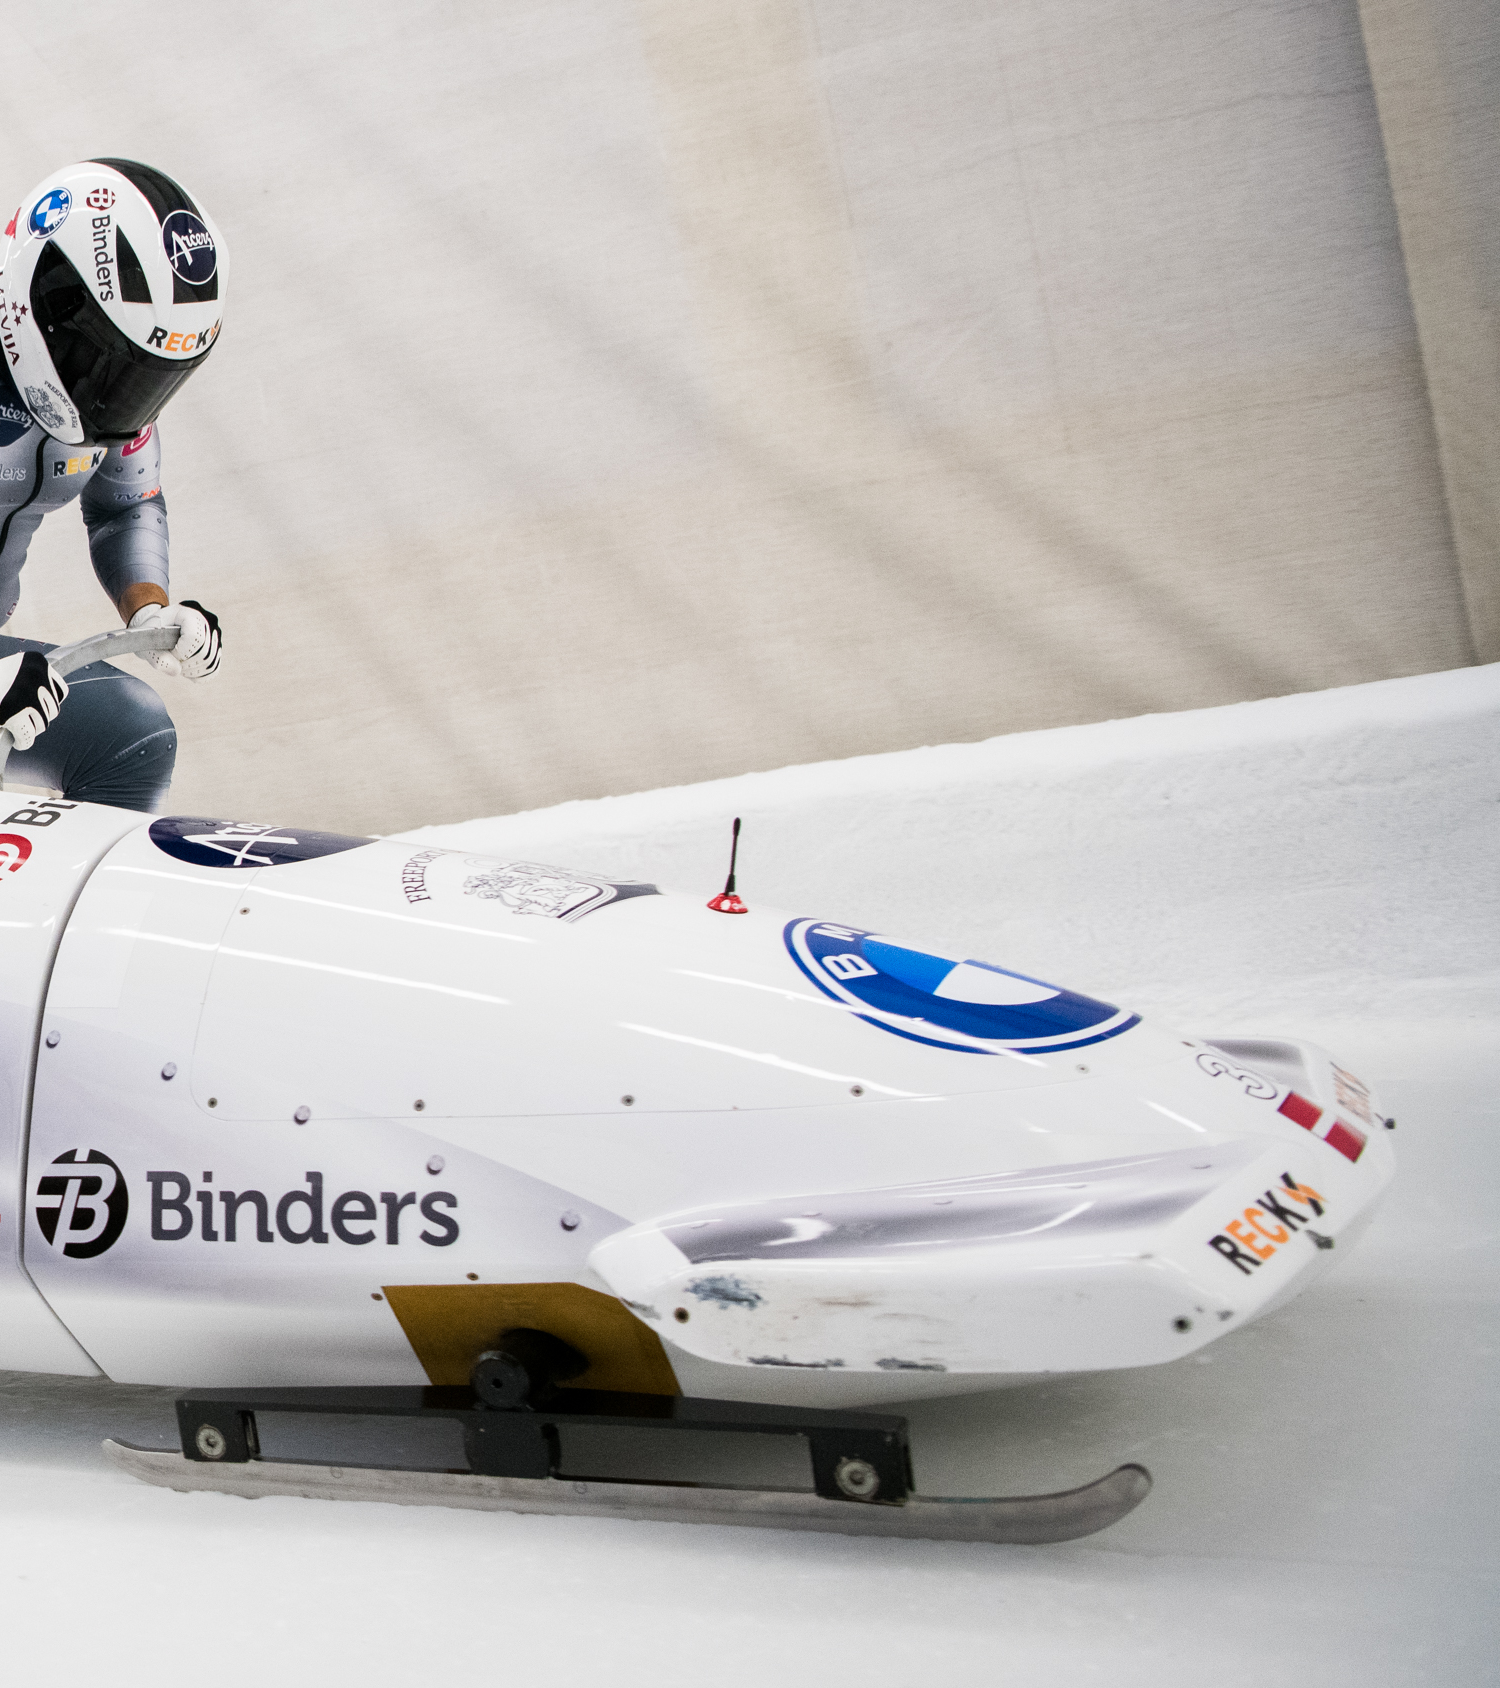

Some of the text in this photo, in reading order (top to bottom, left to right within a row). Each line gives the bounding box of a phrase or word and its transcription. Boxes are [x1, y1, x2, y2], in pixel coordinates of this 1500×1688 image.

[92, 214, 115, 302] Binders
[43, 380, 72, 408] FREEPORT
[146, 1170, 460, 1248] Binders
